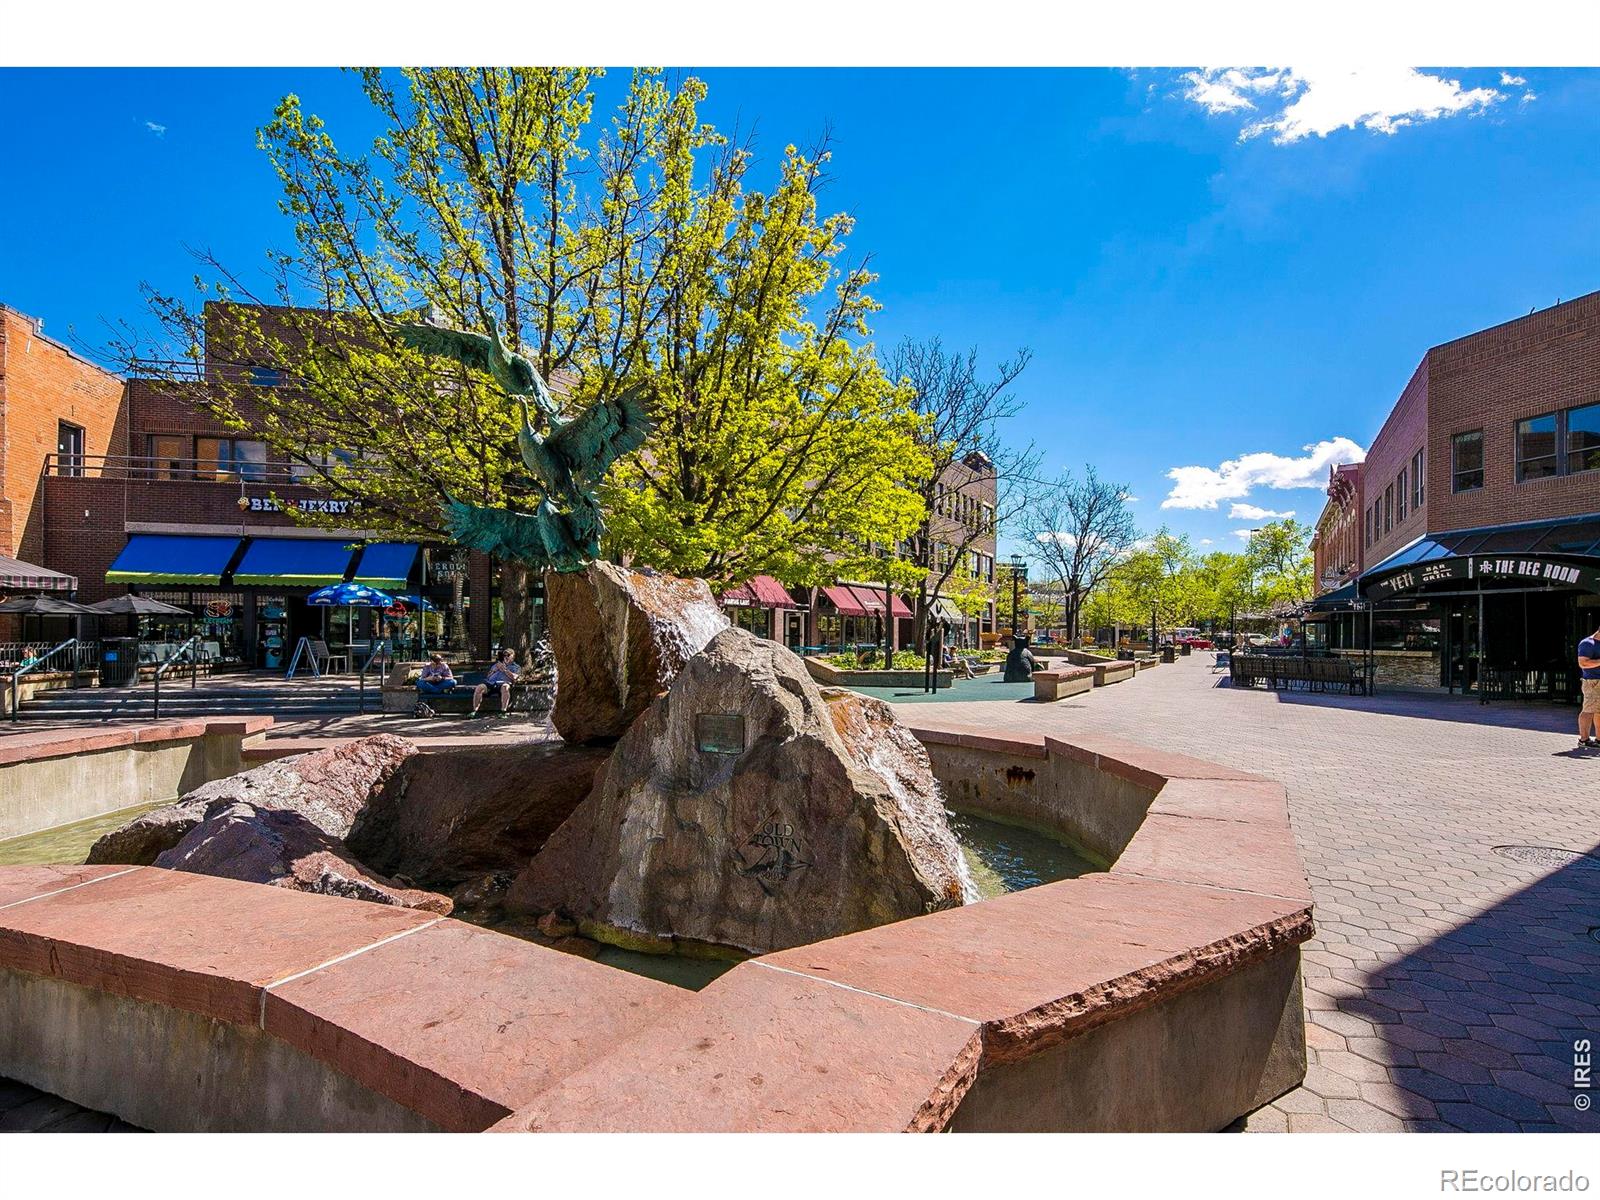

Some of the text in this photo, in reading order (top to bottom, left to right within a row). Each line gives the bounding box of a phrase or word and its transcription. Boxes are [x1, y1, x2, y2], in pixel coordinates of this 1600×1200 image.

[1425, 564, 1446, 572] BAR
[1495, 560, 1515, 574] THE
[1518, 561, 1541, 576] REC
[1543, 563, 1580, 584] ROOM
[1389, 572, 1414, 591] YETI
[1422, 572, 1452, 582] GRILL
[763, 822, 794, 837] OLD
